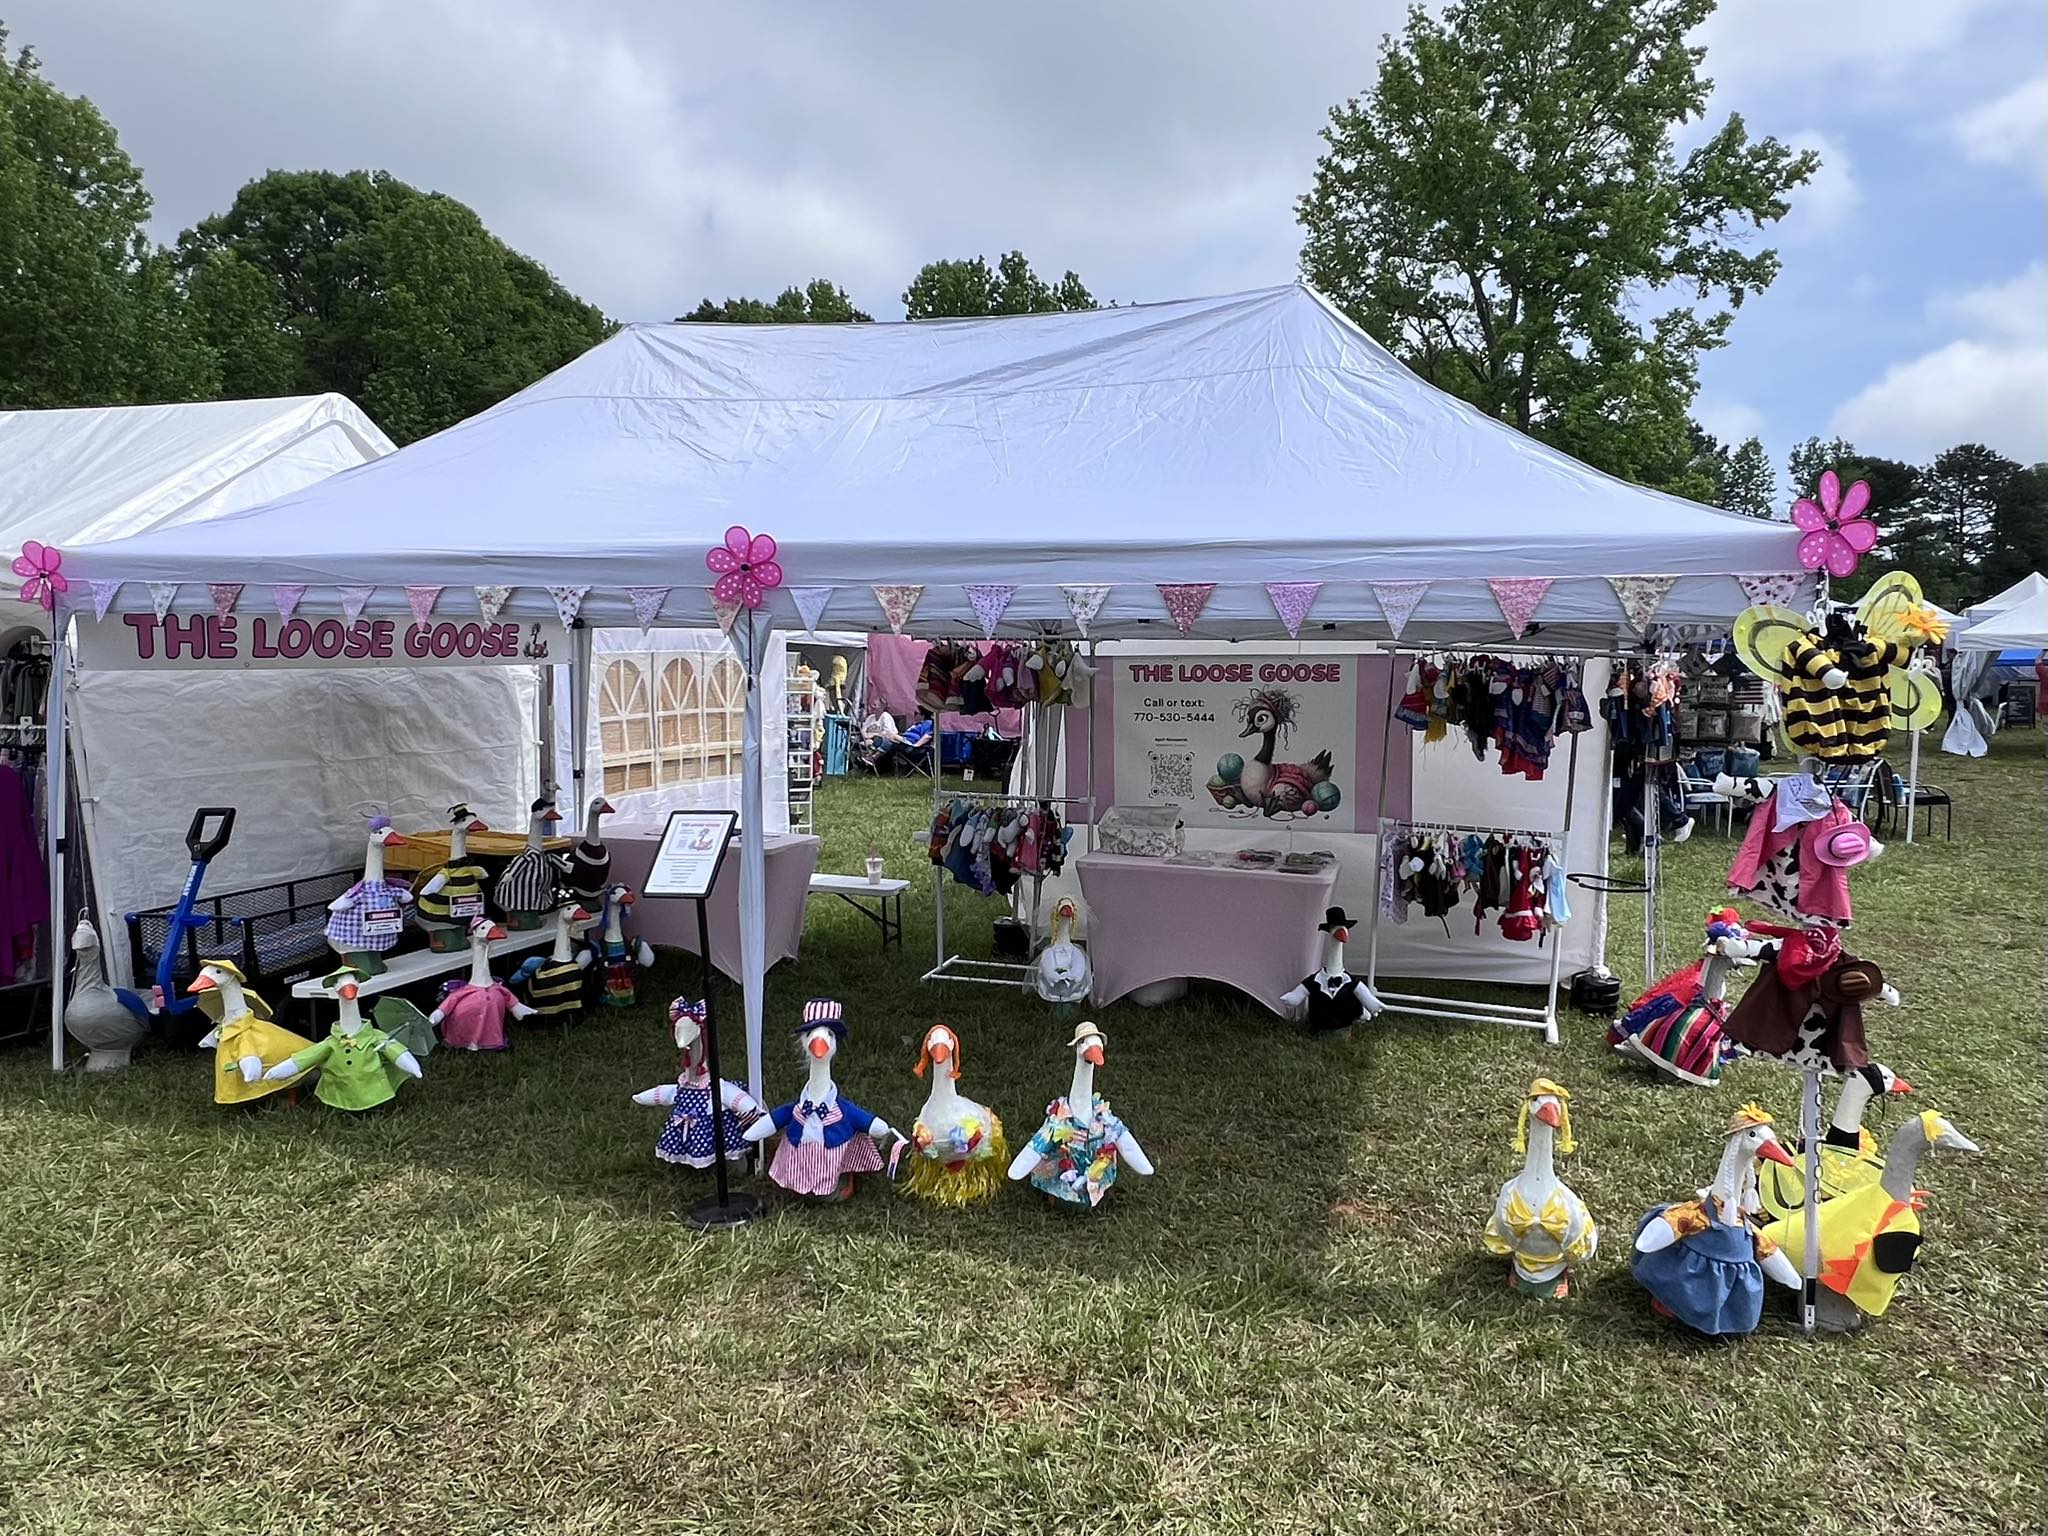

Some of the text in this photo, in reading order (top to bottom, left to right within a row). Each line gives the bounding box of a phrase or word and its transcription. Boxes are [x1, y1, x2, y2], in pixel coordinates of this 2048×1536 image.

[123, 613, 520, 660] THE LOOSE GOOSE
[1129, 664, 1341, 683] THE LOOSE GOOSE
[1143, 697, 1164, 707] Call
[1180, 699, 1205, 708] text:
[1134, 712, 1215, 722] 770-530-5444
